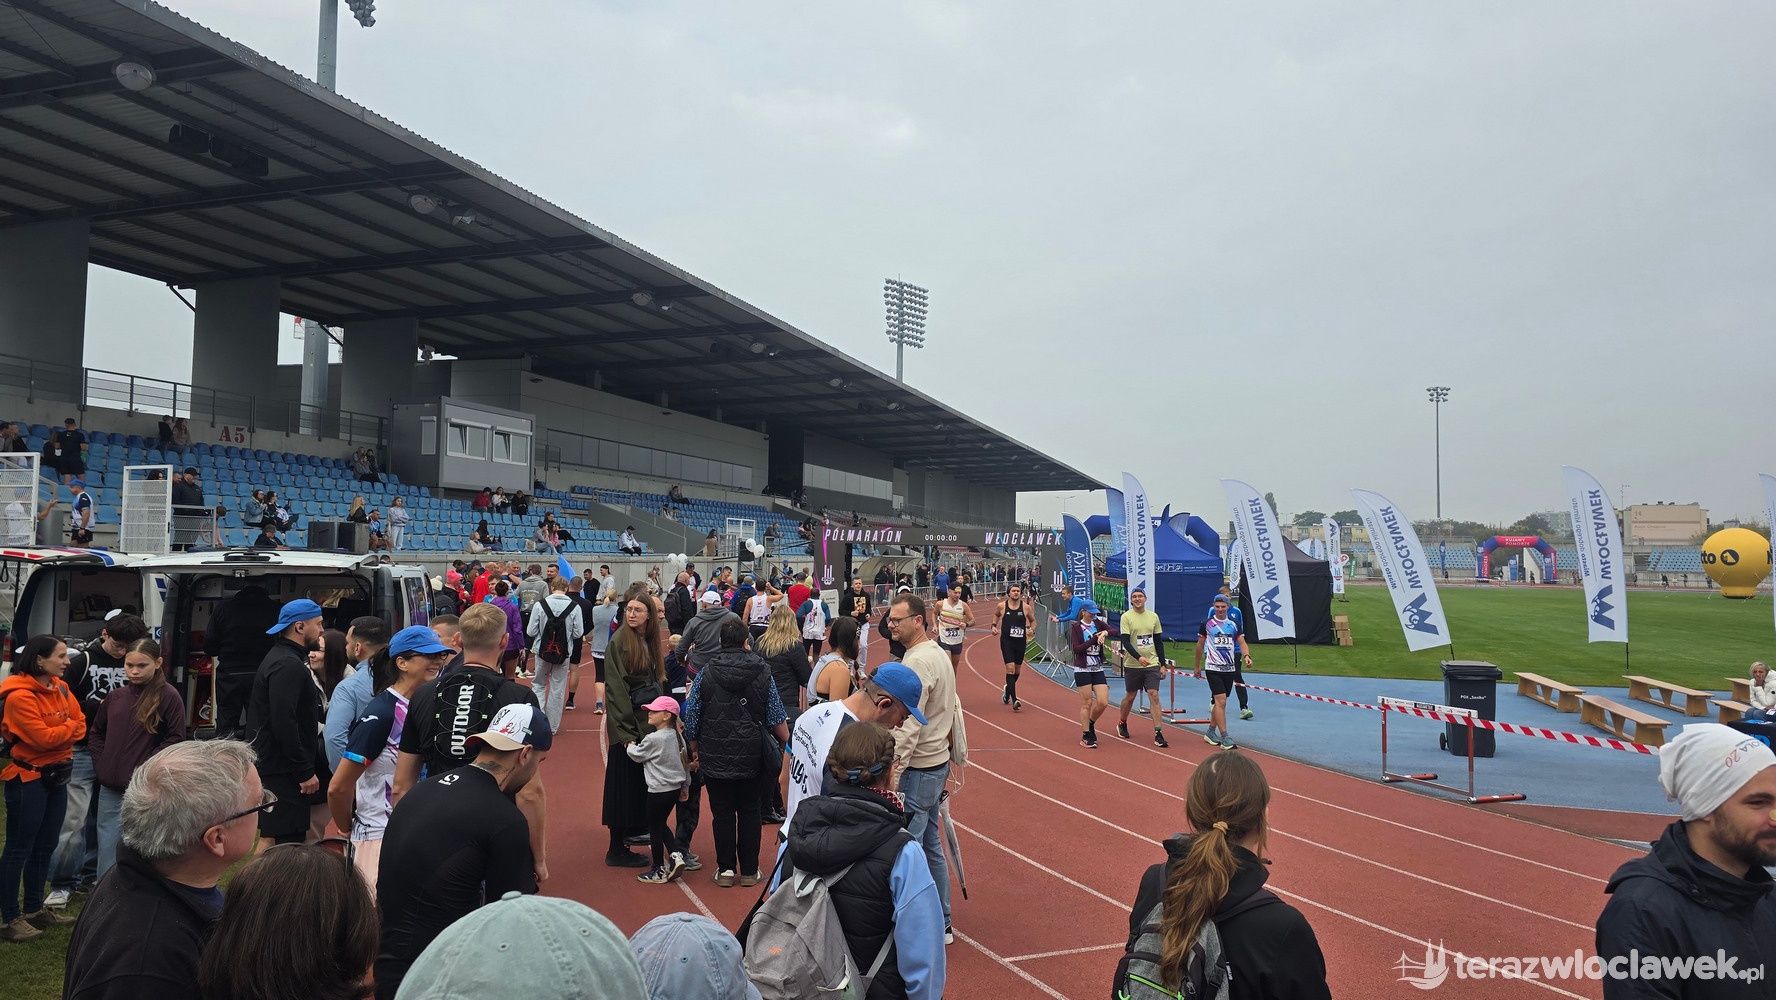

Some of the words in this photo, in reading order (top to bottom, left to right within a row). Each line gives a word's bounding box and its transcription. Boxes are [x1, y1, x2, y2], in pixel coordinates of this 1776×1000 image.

[218, 426, 245, 444] A5
[825, 527, 902, 543] PÓŁMARATON
[985, 532, 1063, 545] WŁOCŁAWEK
[451, 685, 475, 755] OUTDOOR
